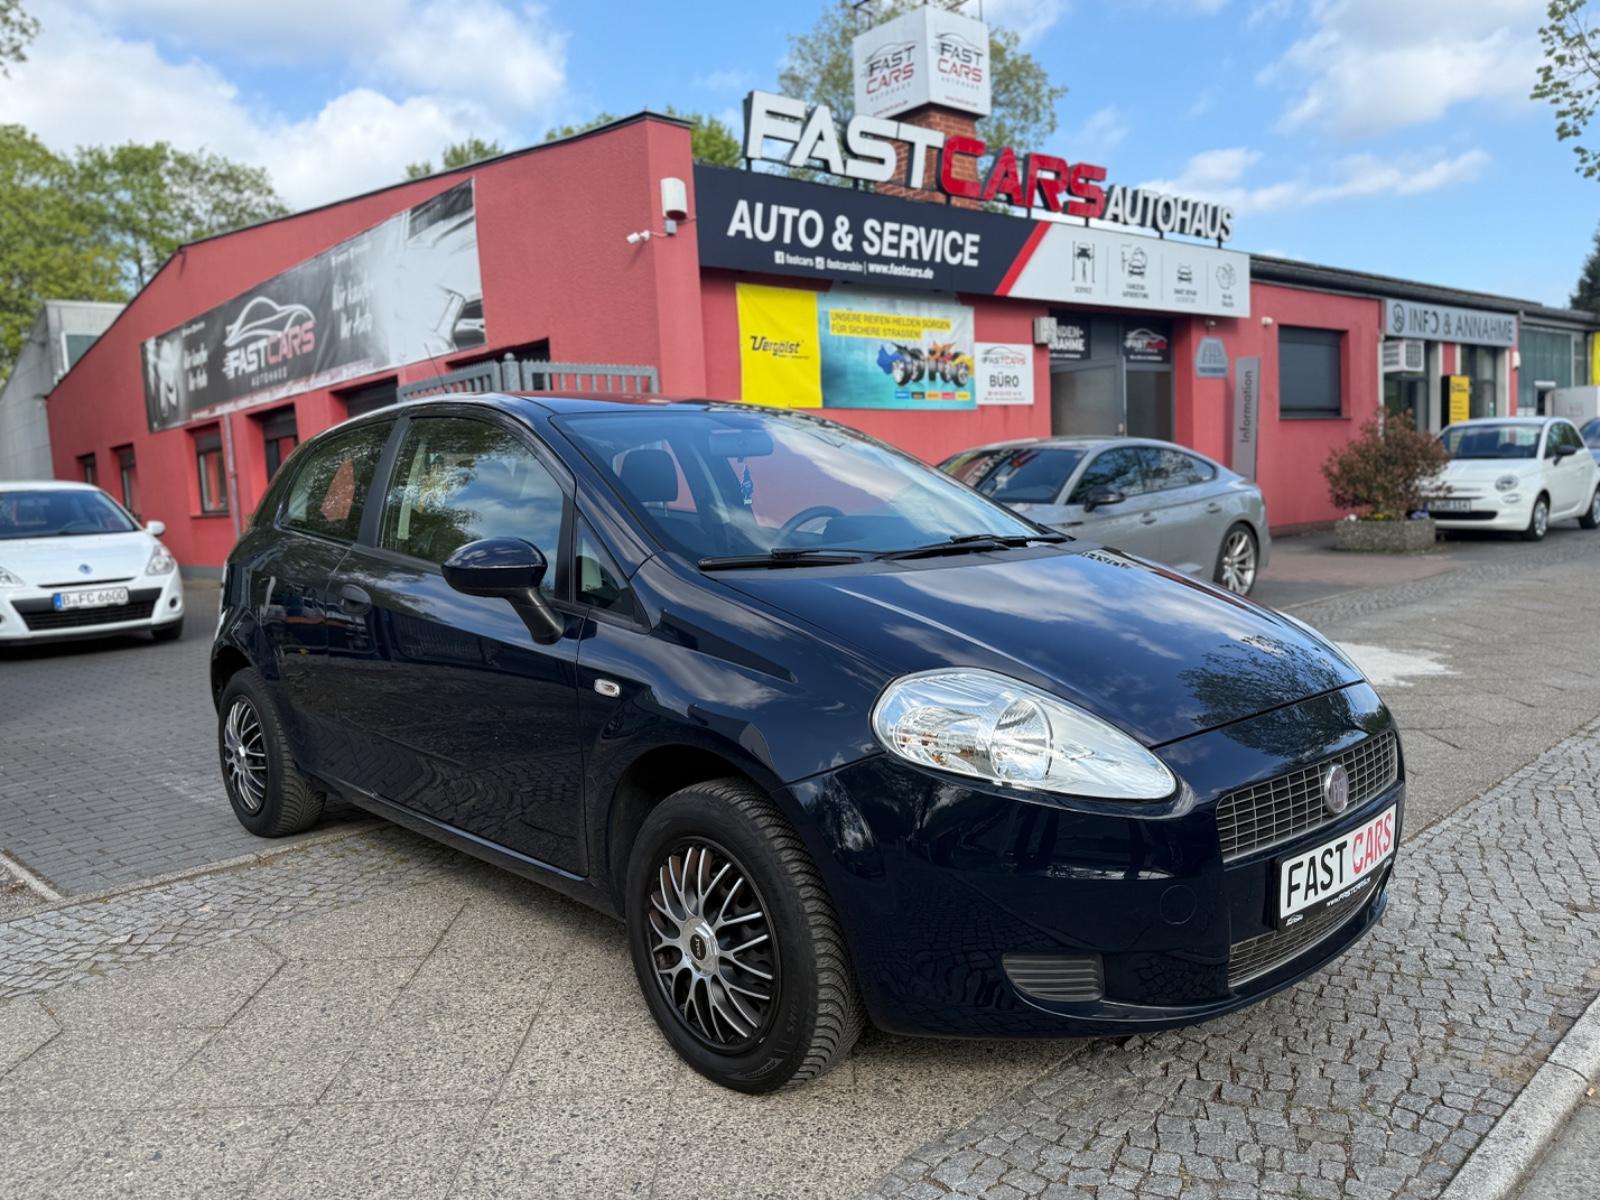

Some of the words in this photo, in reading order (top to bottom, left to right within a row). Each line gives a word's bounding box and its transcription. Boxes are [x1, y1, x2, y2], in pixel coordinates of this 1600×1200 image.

[868, 45, 916, 77] FAST
[940, 42, 983, 66] FAST
[866, 63, 915, 95] CARS
[938, 58, 983, 82] CARS
[1104, 183, 1234, 242] AUTOHAUS
[726, 199, 824, 248] AUTO
[831, 214, 853, 252] &
[862, 218, 981, 267] SERVICE
[868, 262, 934, 280] www.fastcars.de
[831, 312, 862, 324] UNSERE
[922, 319, 951, 330] SORGEN
[831, 322, 848, 333] FÜR
[849, 325, 881, 336] SICHERE
[1408, 307, 1439, 334] INFO
[1443, 313, 1452, 335] &
[1455, 315, 1513, 342] ANNAHME
[989, 371, 1020, 388] BÜRO
[1239, 370, 1253, 444] Information
[63, 593, 70, 605] B
[79, 592, 95, 603] FC
[1286, 841, 1348, 908] FAST
[1352, 812, 1393, 874] CARS
